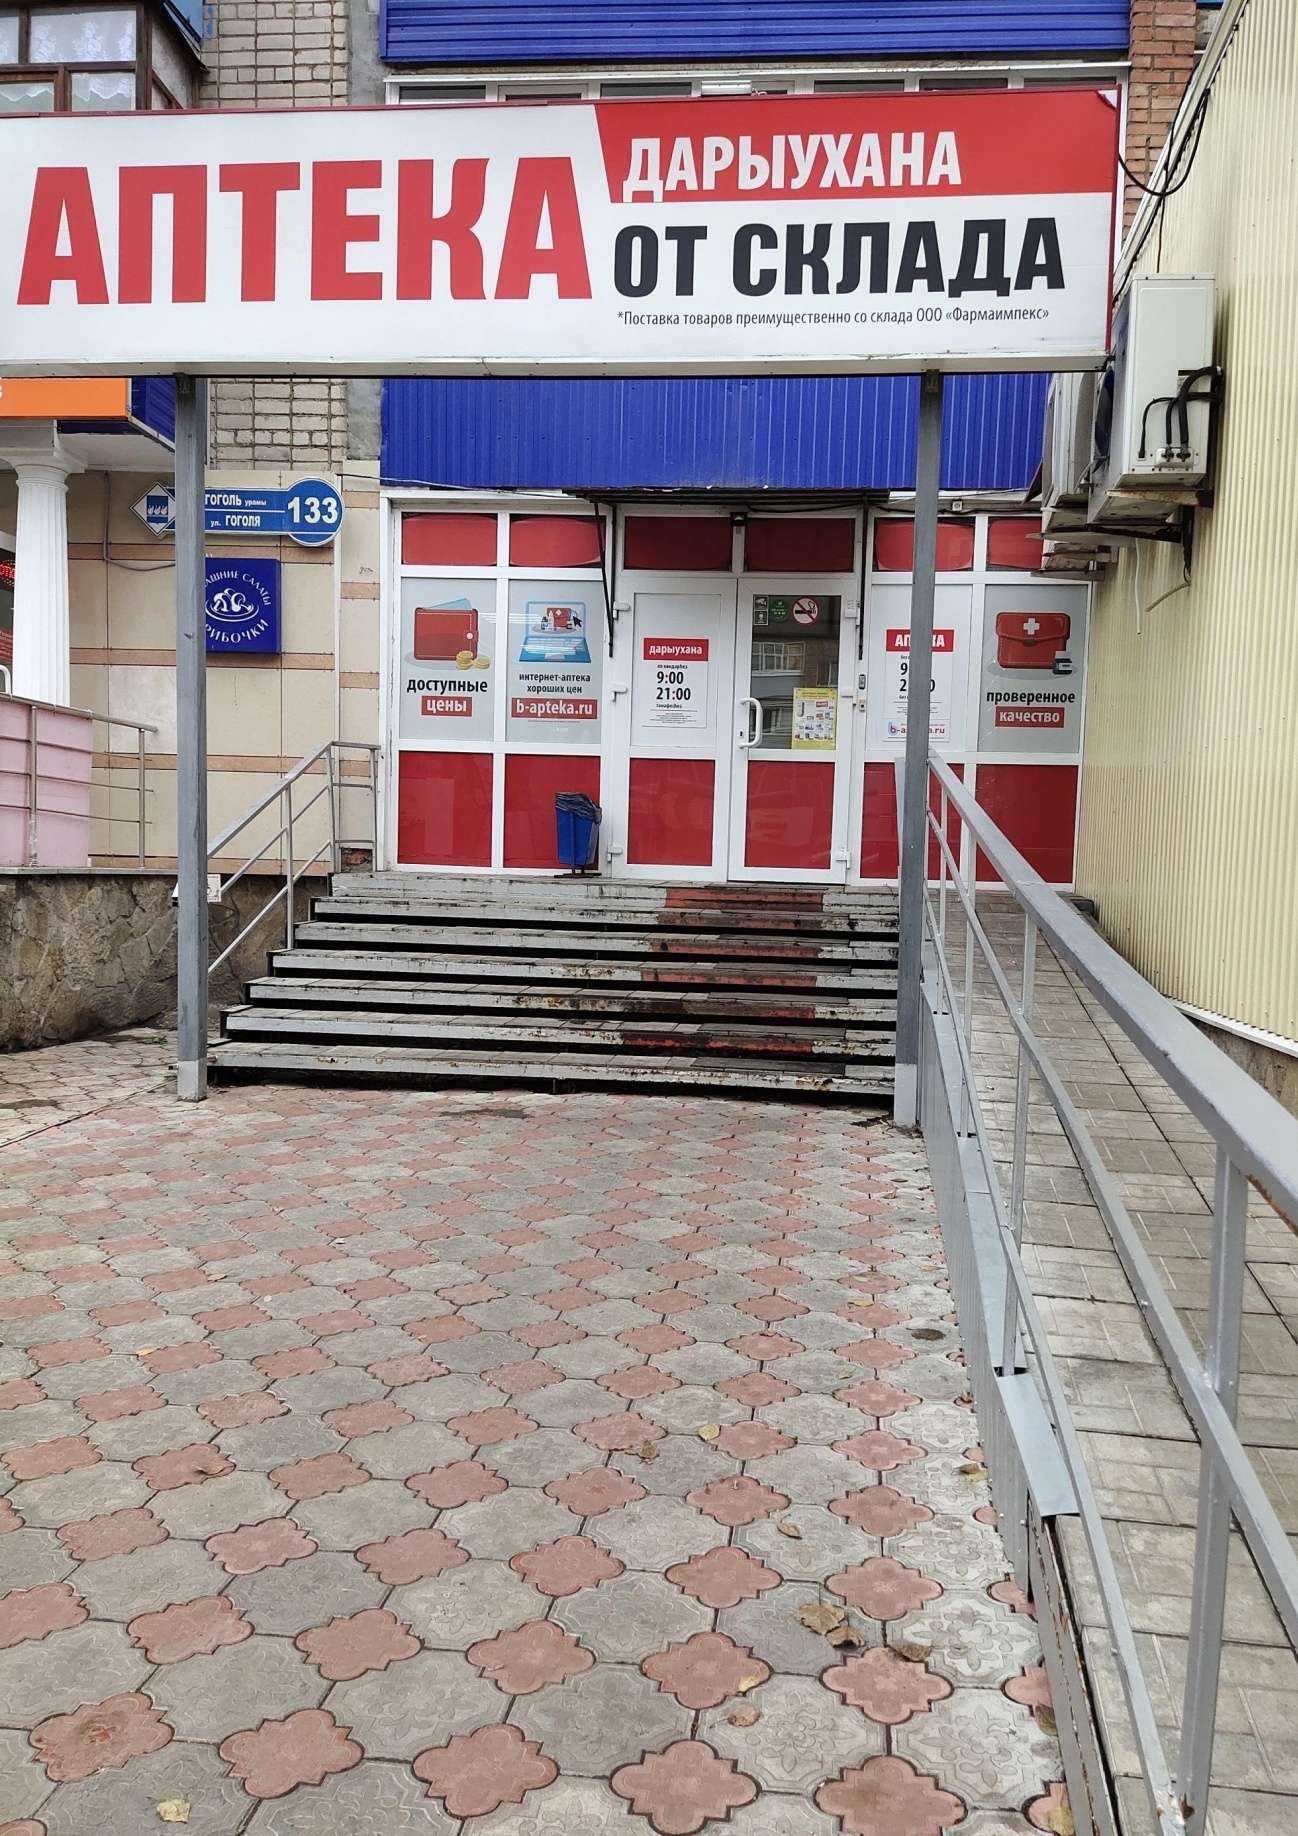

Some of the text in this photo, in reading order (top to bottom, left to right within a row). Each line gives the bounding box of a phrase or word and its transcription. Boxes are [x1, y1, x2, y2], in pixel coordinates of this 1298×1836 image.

[623, 131, 962, 202] ДАРЫУХАНА
[17, 157, 592, 305] АПТЕКА
[613, 217, 1065, 298] ОТ СКЛАДА
[684, 312, 733, 328] товаров
[736, 311, 850, 328] преимущественно
[854, 311, 867, 323] со
[870, 310, 913, 325] склада
[916, 307, 942, 322] ООО
[945, 306, 1049, 325] «Фармаимпекс»
[244, 498, 267, 507] урамы
[287, 496, 338, 524] 133
[225, 514, 261, 527] ГОГОЛЯ
[204, 570, 240, 588] АШНИЕ
[205, 618, 269, 644] РИБОЧКИ
[649, 644, 703, 656] дарыухана
[519, 673, 591, 683] интернет-аптека
[656, 670, 684, 685] 9:00
[406, 679, 488, 695] доступные
[526, 684, 583, 695] хороших цен
[656, 687, 691, 700] 21:00
[986, 691, 1076, 706] проверенное
[426, 699, 467, 714] цены
[516, 698, 593, 717] b-apteka.ru
[999, 711, 1060, 723] качество
